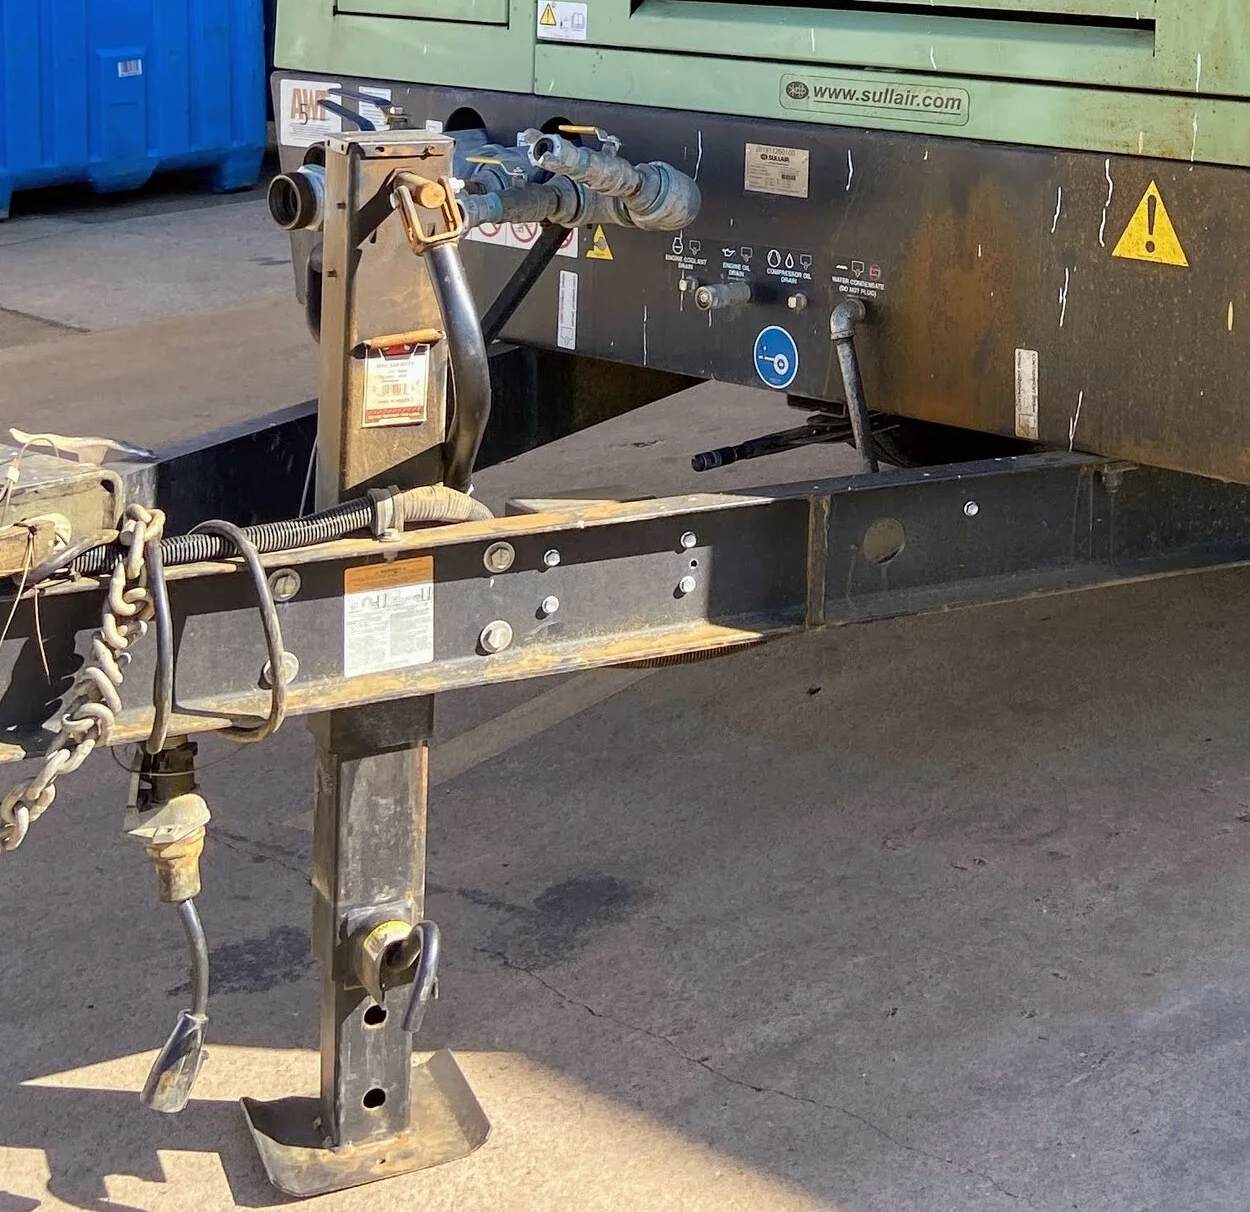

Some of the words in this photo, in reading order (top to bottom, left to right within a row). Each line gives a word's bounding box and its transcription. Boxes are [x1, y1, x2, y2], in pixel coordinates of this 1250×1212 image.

[813, 85, 962, 111] www.sullair.com
[768, 154, 790, 162] SULLAIR
[665, 254, 683, 262] ENGINE
[683, 256, 707, 265] COOLANT
[678, 262, 694, 270] DRAIN
[722, 262, 741, 270] ENGINE
[742, 264, 751, 272] OIL
[766, 268, 802, 278] COMPRESSOR
[803, 272, 811, 280] OIL
[780, 276, 797, 284] DRAIN
[831, 276, 849, 285] WATER
[849, 278, 885, 290] CONDENSATE
